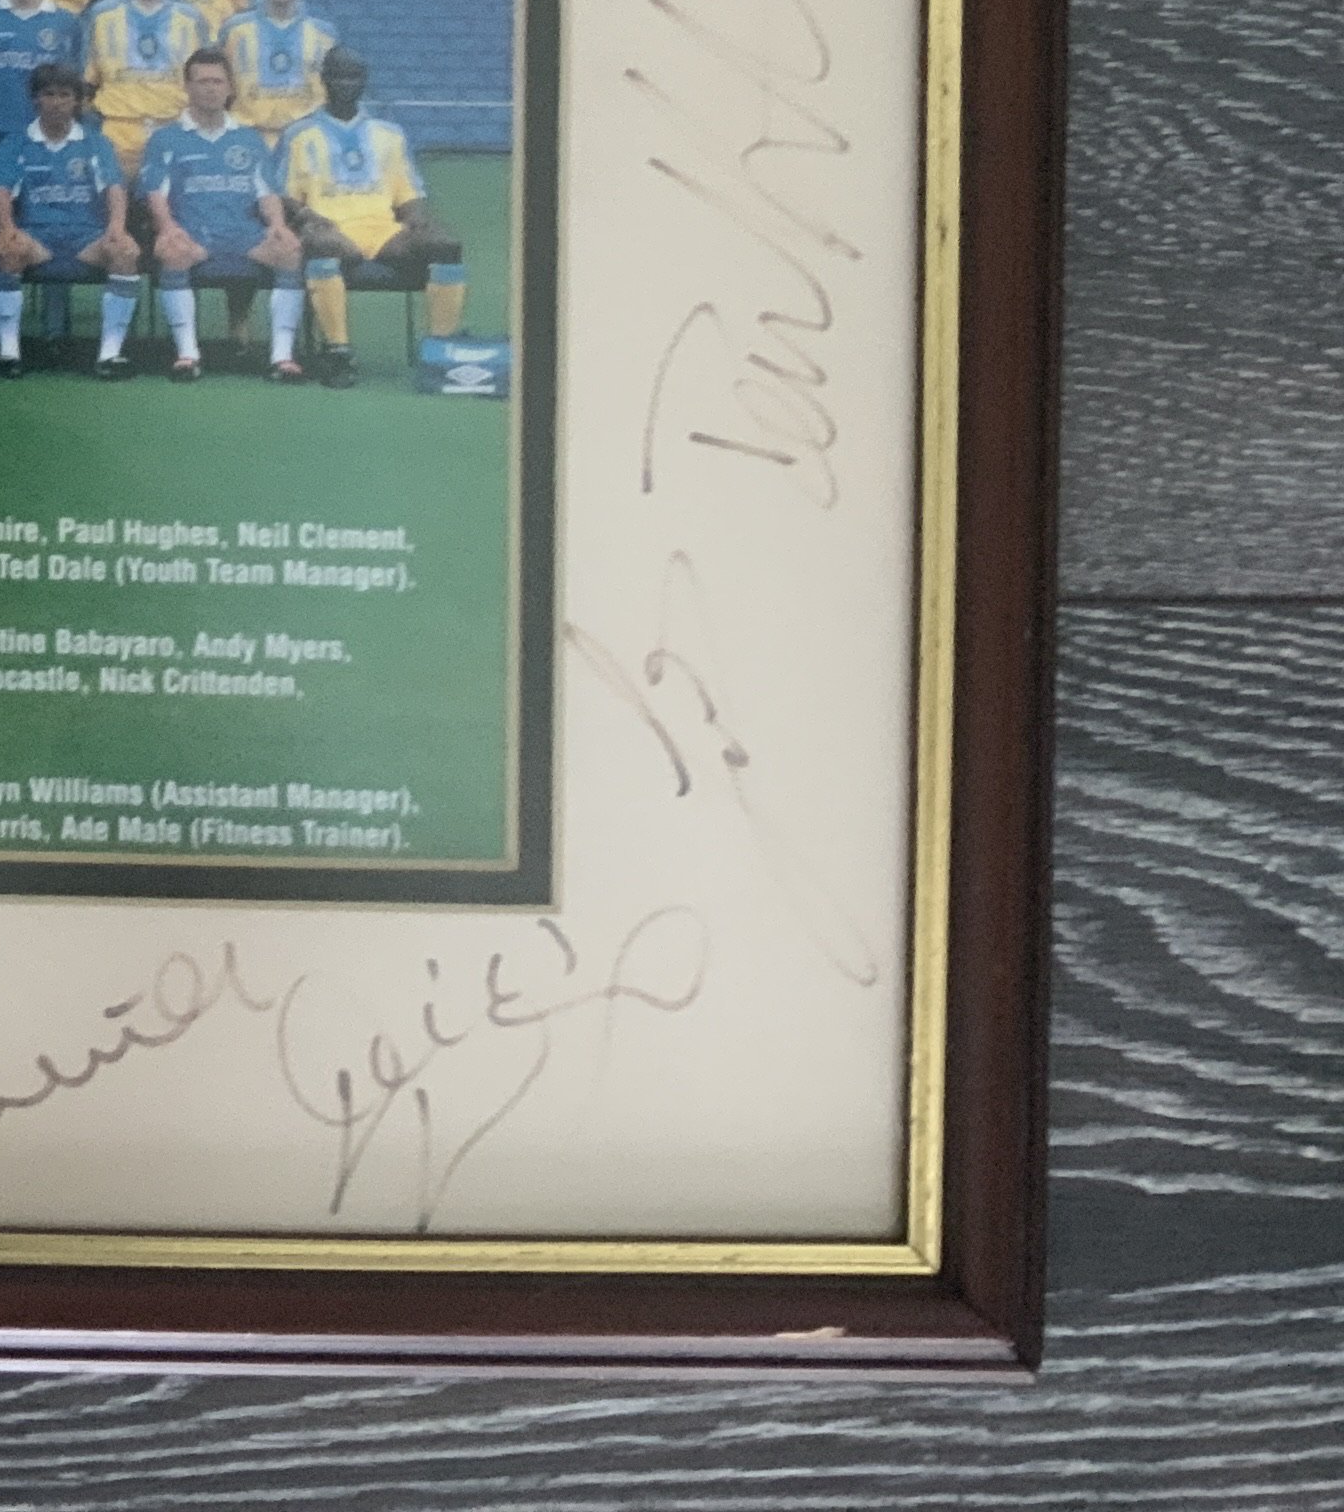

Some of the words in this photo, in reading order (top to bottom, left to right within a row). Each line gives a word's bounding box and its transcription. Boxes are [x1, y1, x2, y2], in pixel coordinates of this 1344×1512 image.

[57, 517, 115, 545] Paul
[123, 518, 227, 555] Hughes,
[47, 554, 107, 583] Dale
[115, 555, 197, 590] (Youth
[204, 557, 275, 586] Team
[283, 559, 418, 593] Manager).
[192, 632, 256, 668] Andy
[264, 634, 351, 669] Myers,
[98, 666, 155, 694] Nick
[28, 776, 144, 805] Williams
[150, 779, 279, 813] (Assistant
[286, 782, 423, 816] Manager),
[190, 817, 293, 852] (Fitness
[300, 820, 411, 854] Trainer).
